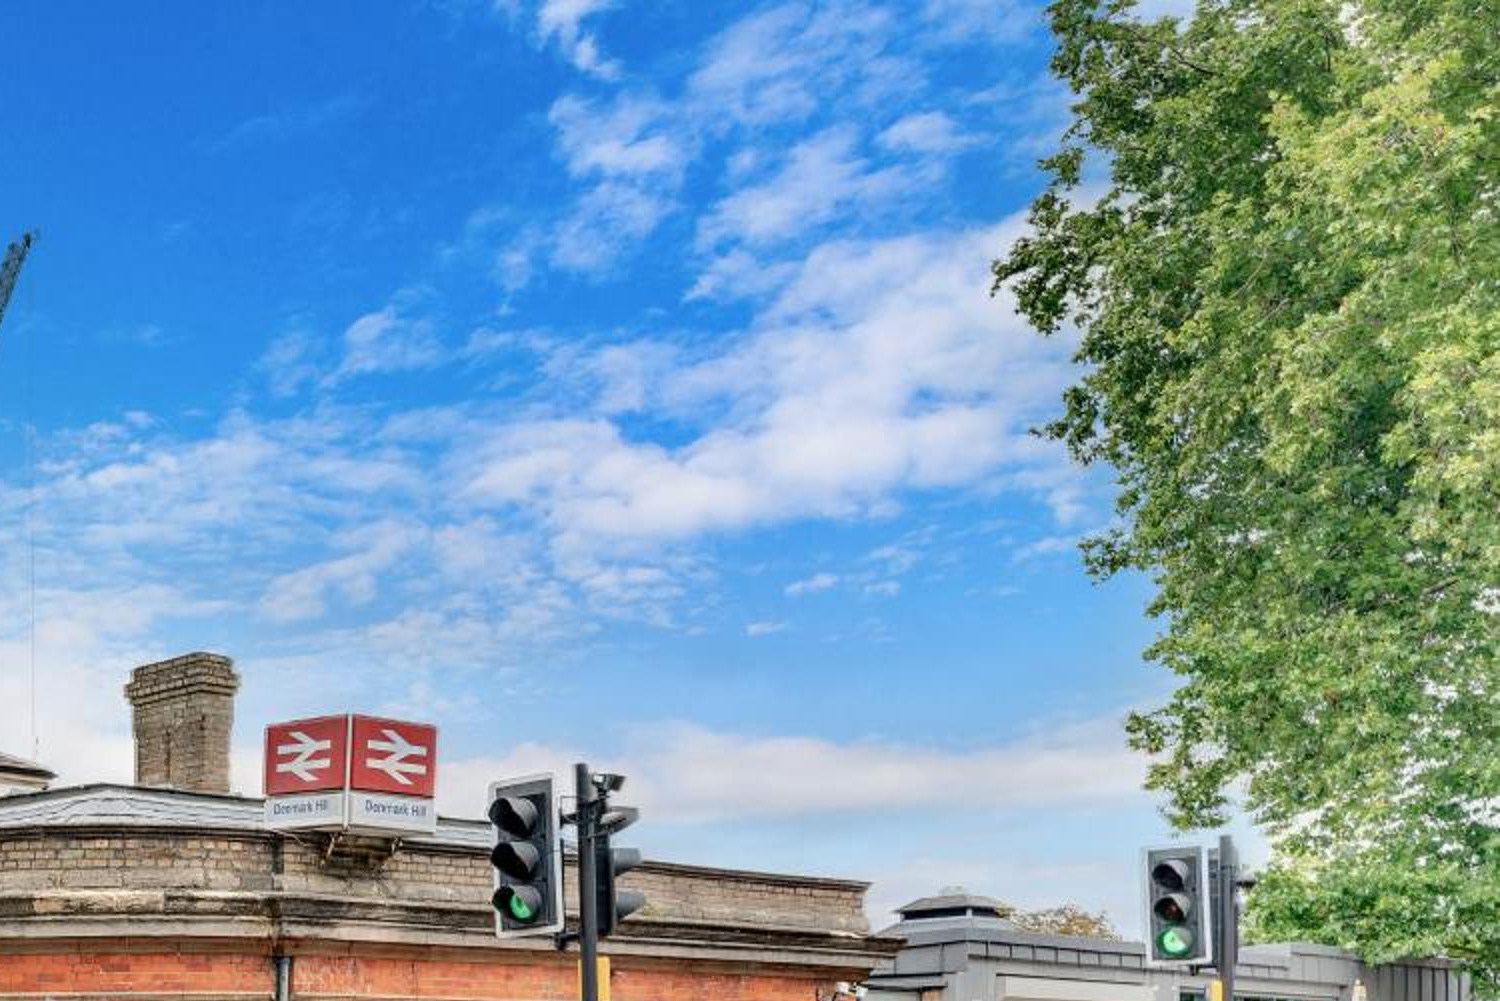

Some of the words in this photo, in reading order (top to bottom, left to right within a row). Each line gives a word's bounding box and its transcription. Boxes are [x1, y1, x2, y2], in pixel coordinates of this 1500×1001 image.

[273, 801, 312, 815] Denmark
[365, 800, 409, 815] Denmark
[411, 806, 427, 817] Hill
